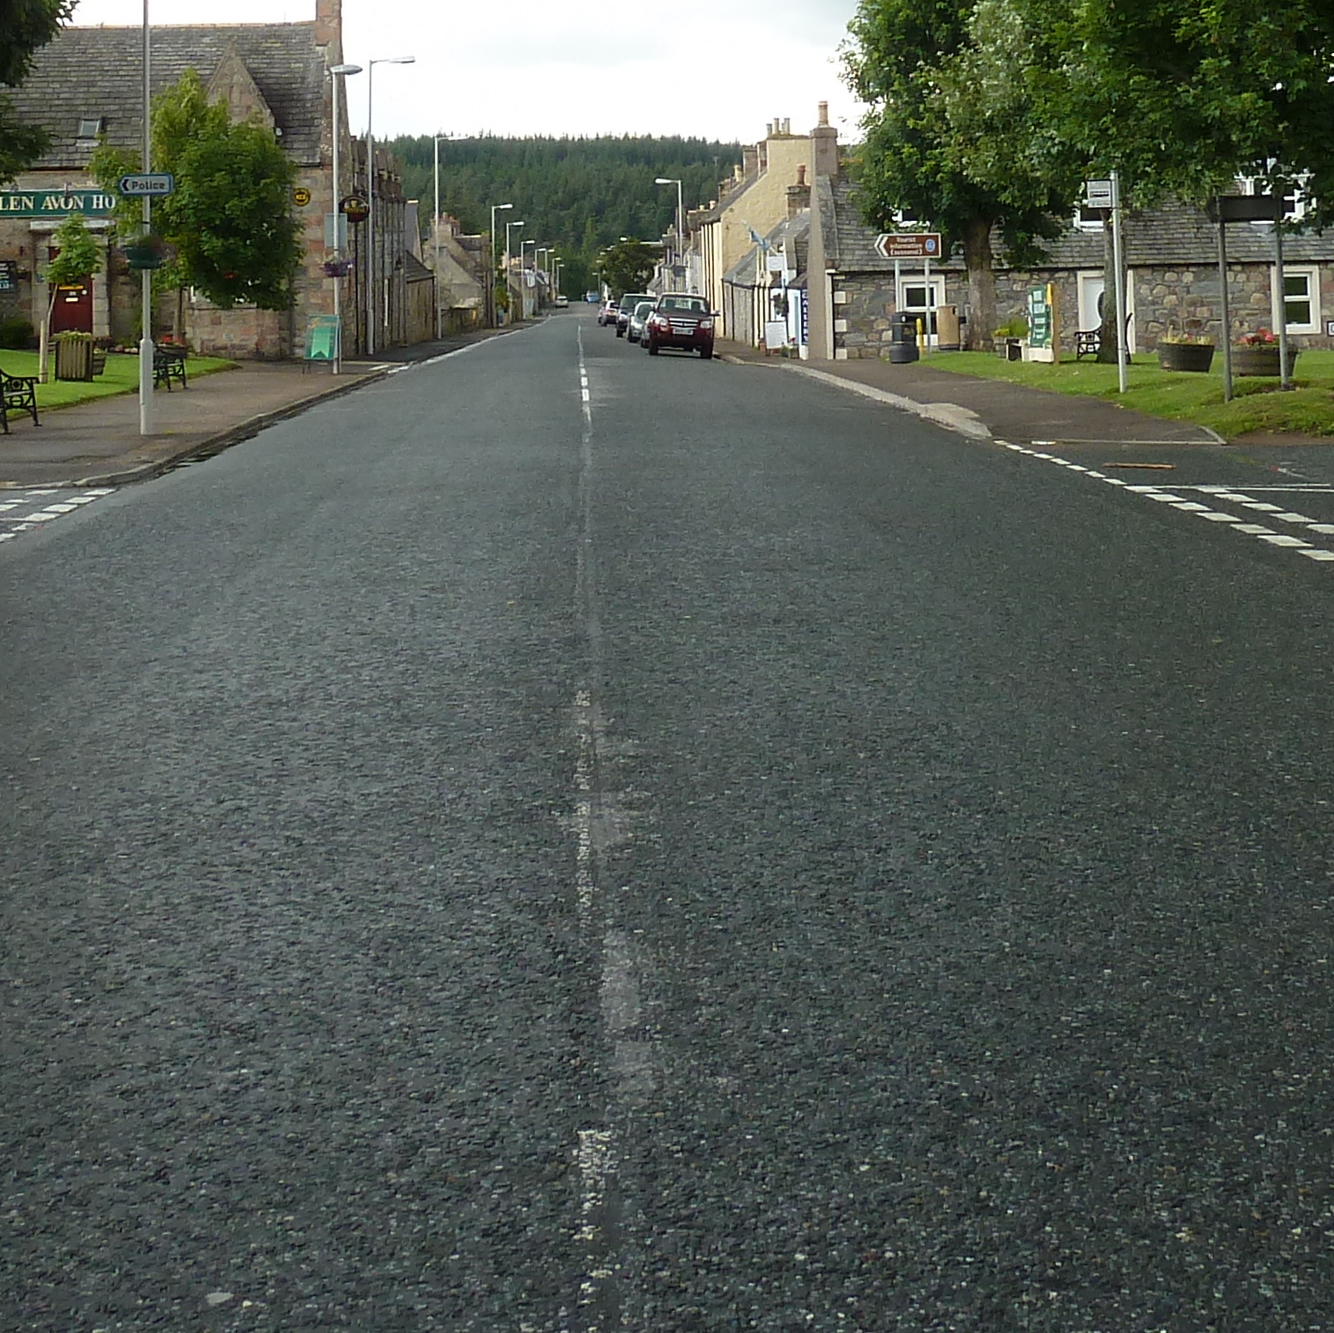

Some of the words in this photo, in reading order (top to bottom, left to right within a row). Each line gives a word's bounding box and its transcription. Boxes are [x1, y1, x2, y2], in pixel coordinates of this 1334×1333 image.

[132, 180, 166, 190] Police
[41, 194, 85, 210] AVON
[92, 194, 116, 209] HO
